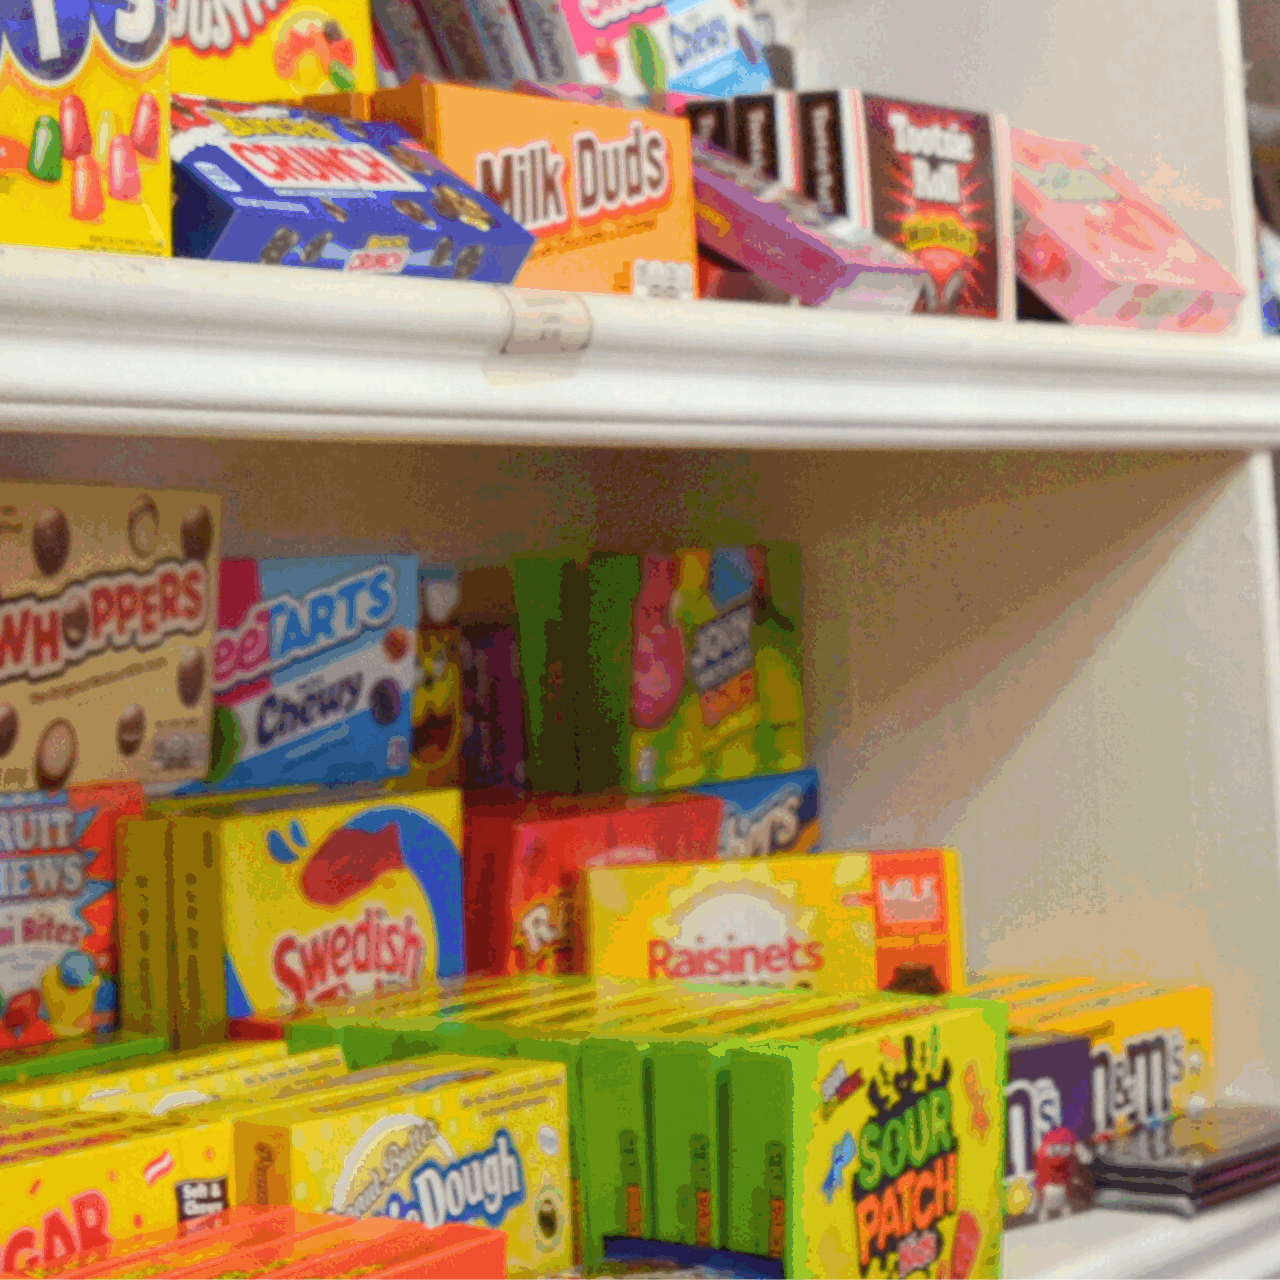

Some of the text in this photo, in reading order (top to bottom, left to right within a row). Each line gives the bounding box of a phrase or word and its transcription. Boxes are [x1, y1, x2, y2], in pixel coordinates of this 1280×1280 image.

[227, 141, 410, 184] CRUNCH
[480, 145, 565, 225] Milk
[577, 126, 666, 210] Duds
[256, 670, 365, 748] Chewy
[20, 913, 82, 946] Bites
[273, 906, 426, 1004] Swedish
[648, 933, 825, 981] Raisinets
[415, 1134, 521, 1230] Dough
[859, 1087, 952, 1190] SOUR
[856, 1152, 957, 1266] PATCH
